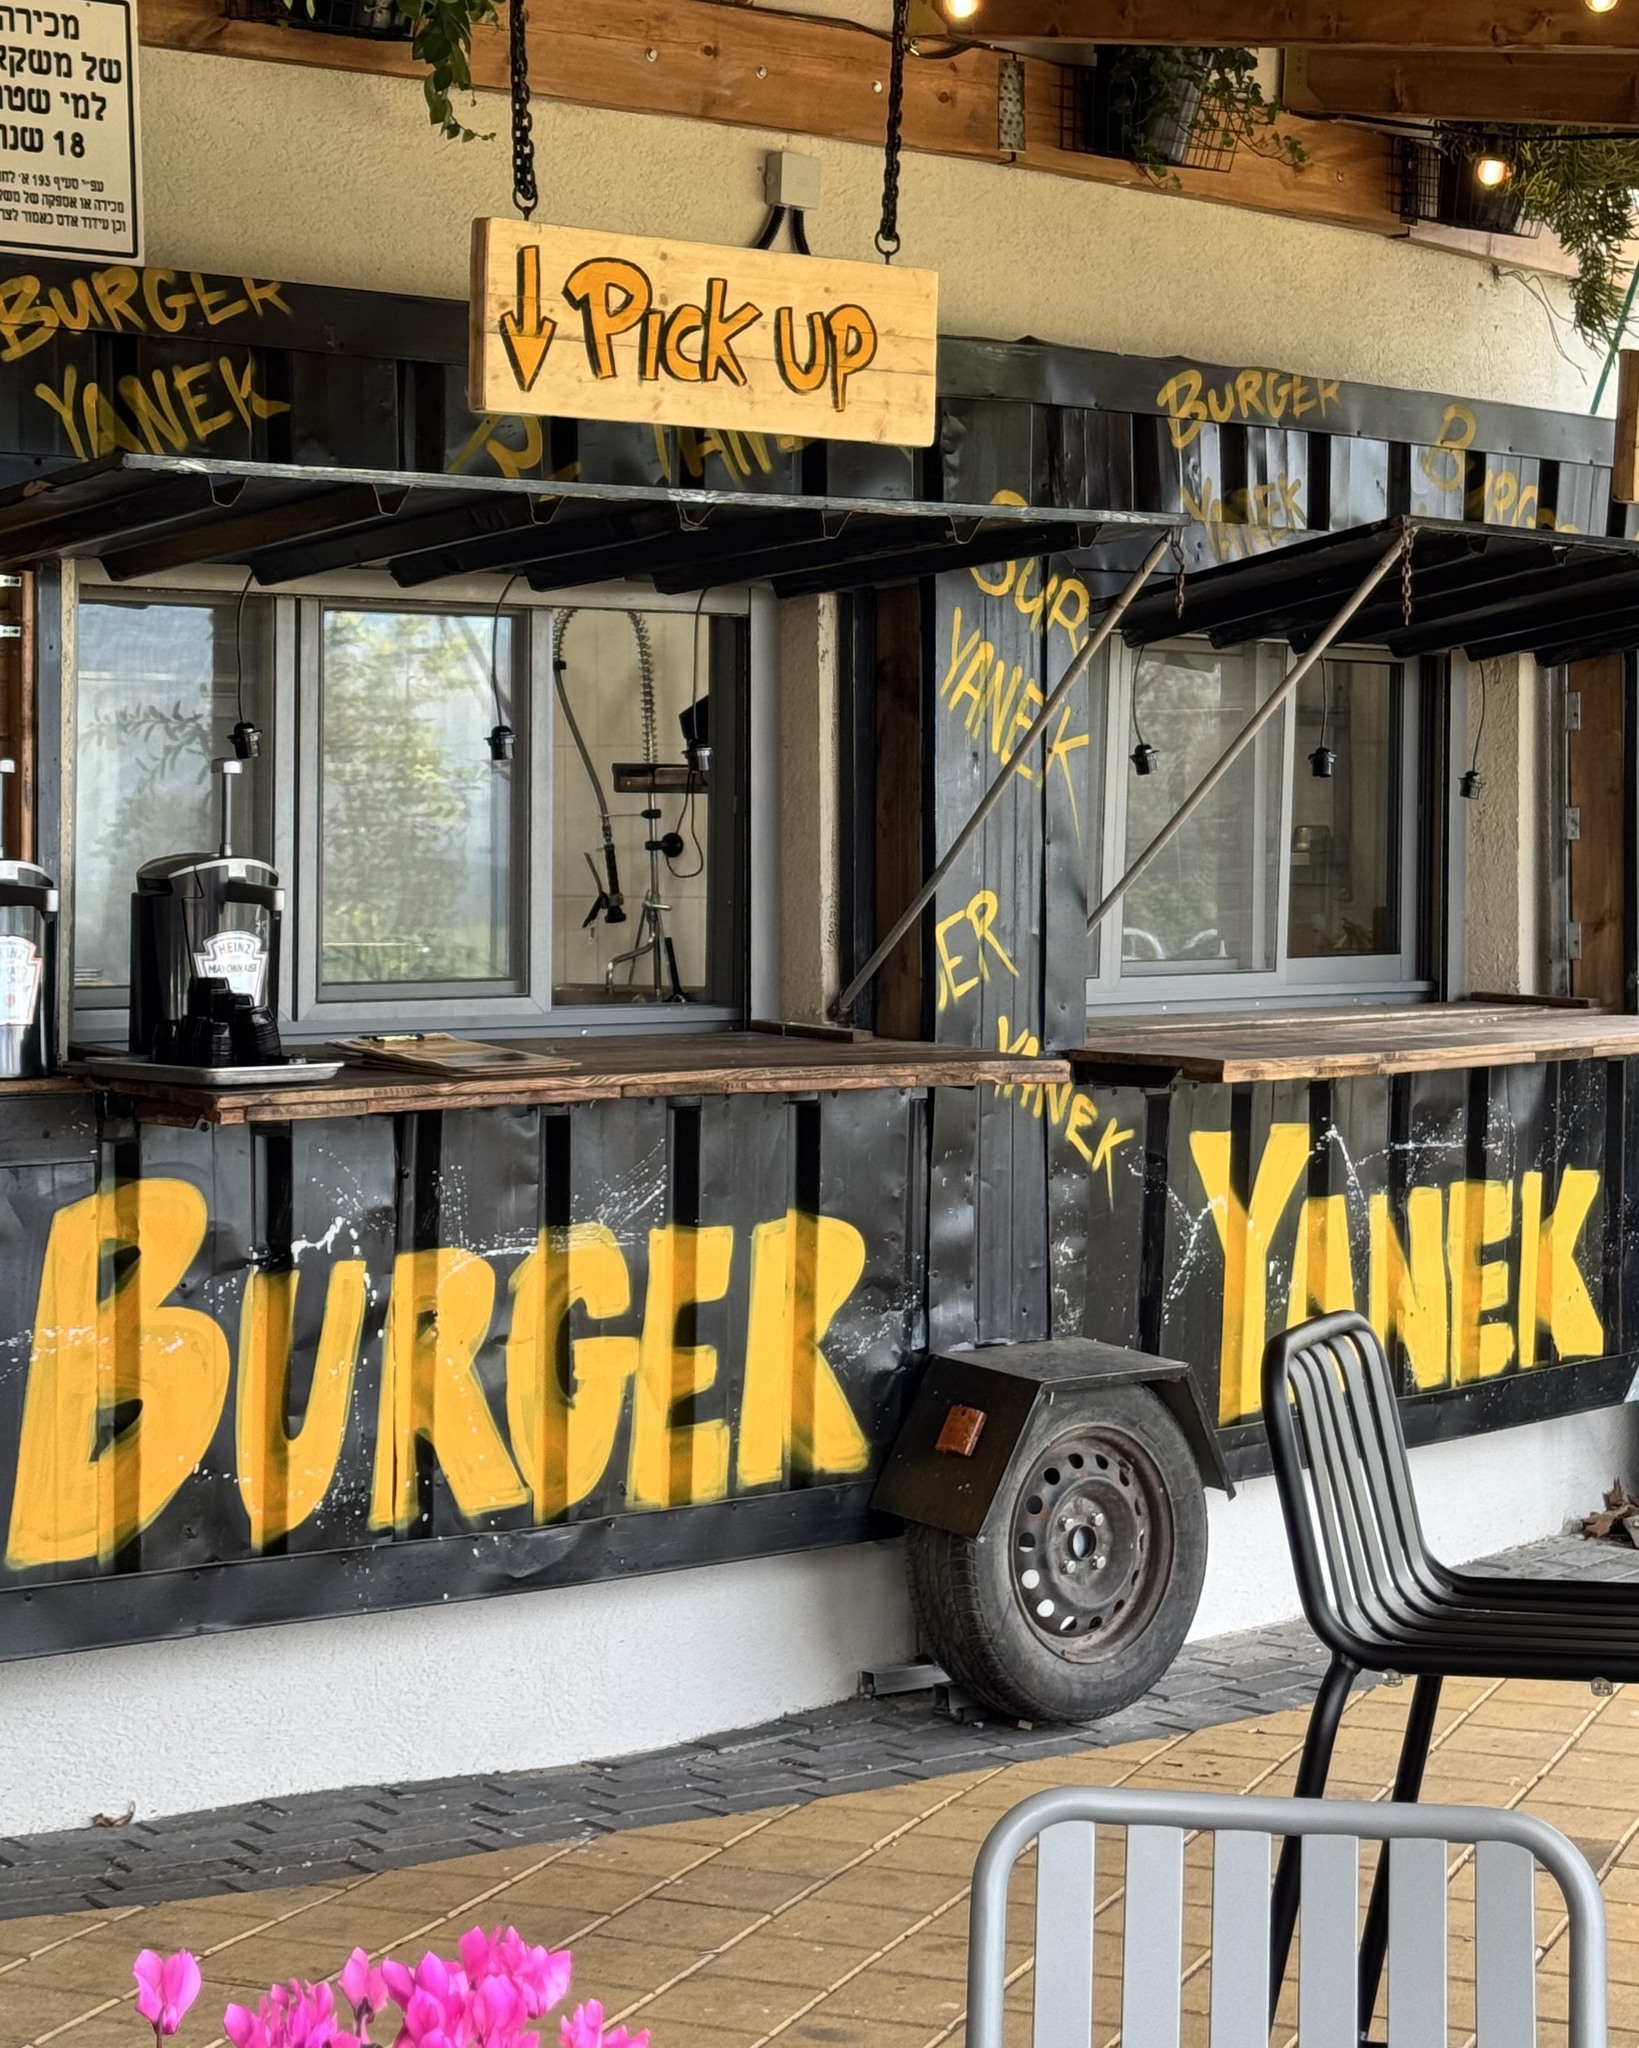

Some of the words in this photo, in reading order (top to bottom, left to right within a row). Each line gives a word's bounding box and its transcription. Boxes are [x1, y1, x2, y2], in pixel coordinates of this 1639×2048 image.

[0, 5, 80, 41] מכירה
[81, 51, 122, 84] של
[0, 84, 51, 115] שט
[59, 91, 107, 121] למי
[53, 130, 85, 159] 18
[31, 173, 51, 188] 193
[53, 175, 79, 191] סעיף
[23, 189, 39, 204] של
[41, 193, 77, 209] אספקה
[79, 196, 92, 211] או
[93, 198, 125, 213] מכירה
[21, 209, 54, 225] כאמור
[56, 213, 79, 228] אדם
[80, 215, 110, 231] עידוד
[111, 218, 127, 234] וכן
[0, 265, 294, 362] BURGER
[34, 355, 292, 462] YANEK
[1157, 368, 1344, 451] BURGER
[938, 606, 1089, 850] YANEK
[217, 941, 252, 956] HEINZ
[1188, 1121, 1605, 1428] YANEK
[4, 1176, 872, 1570] BURGER
